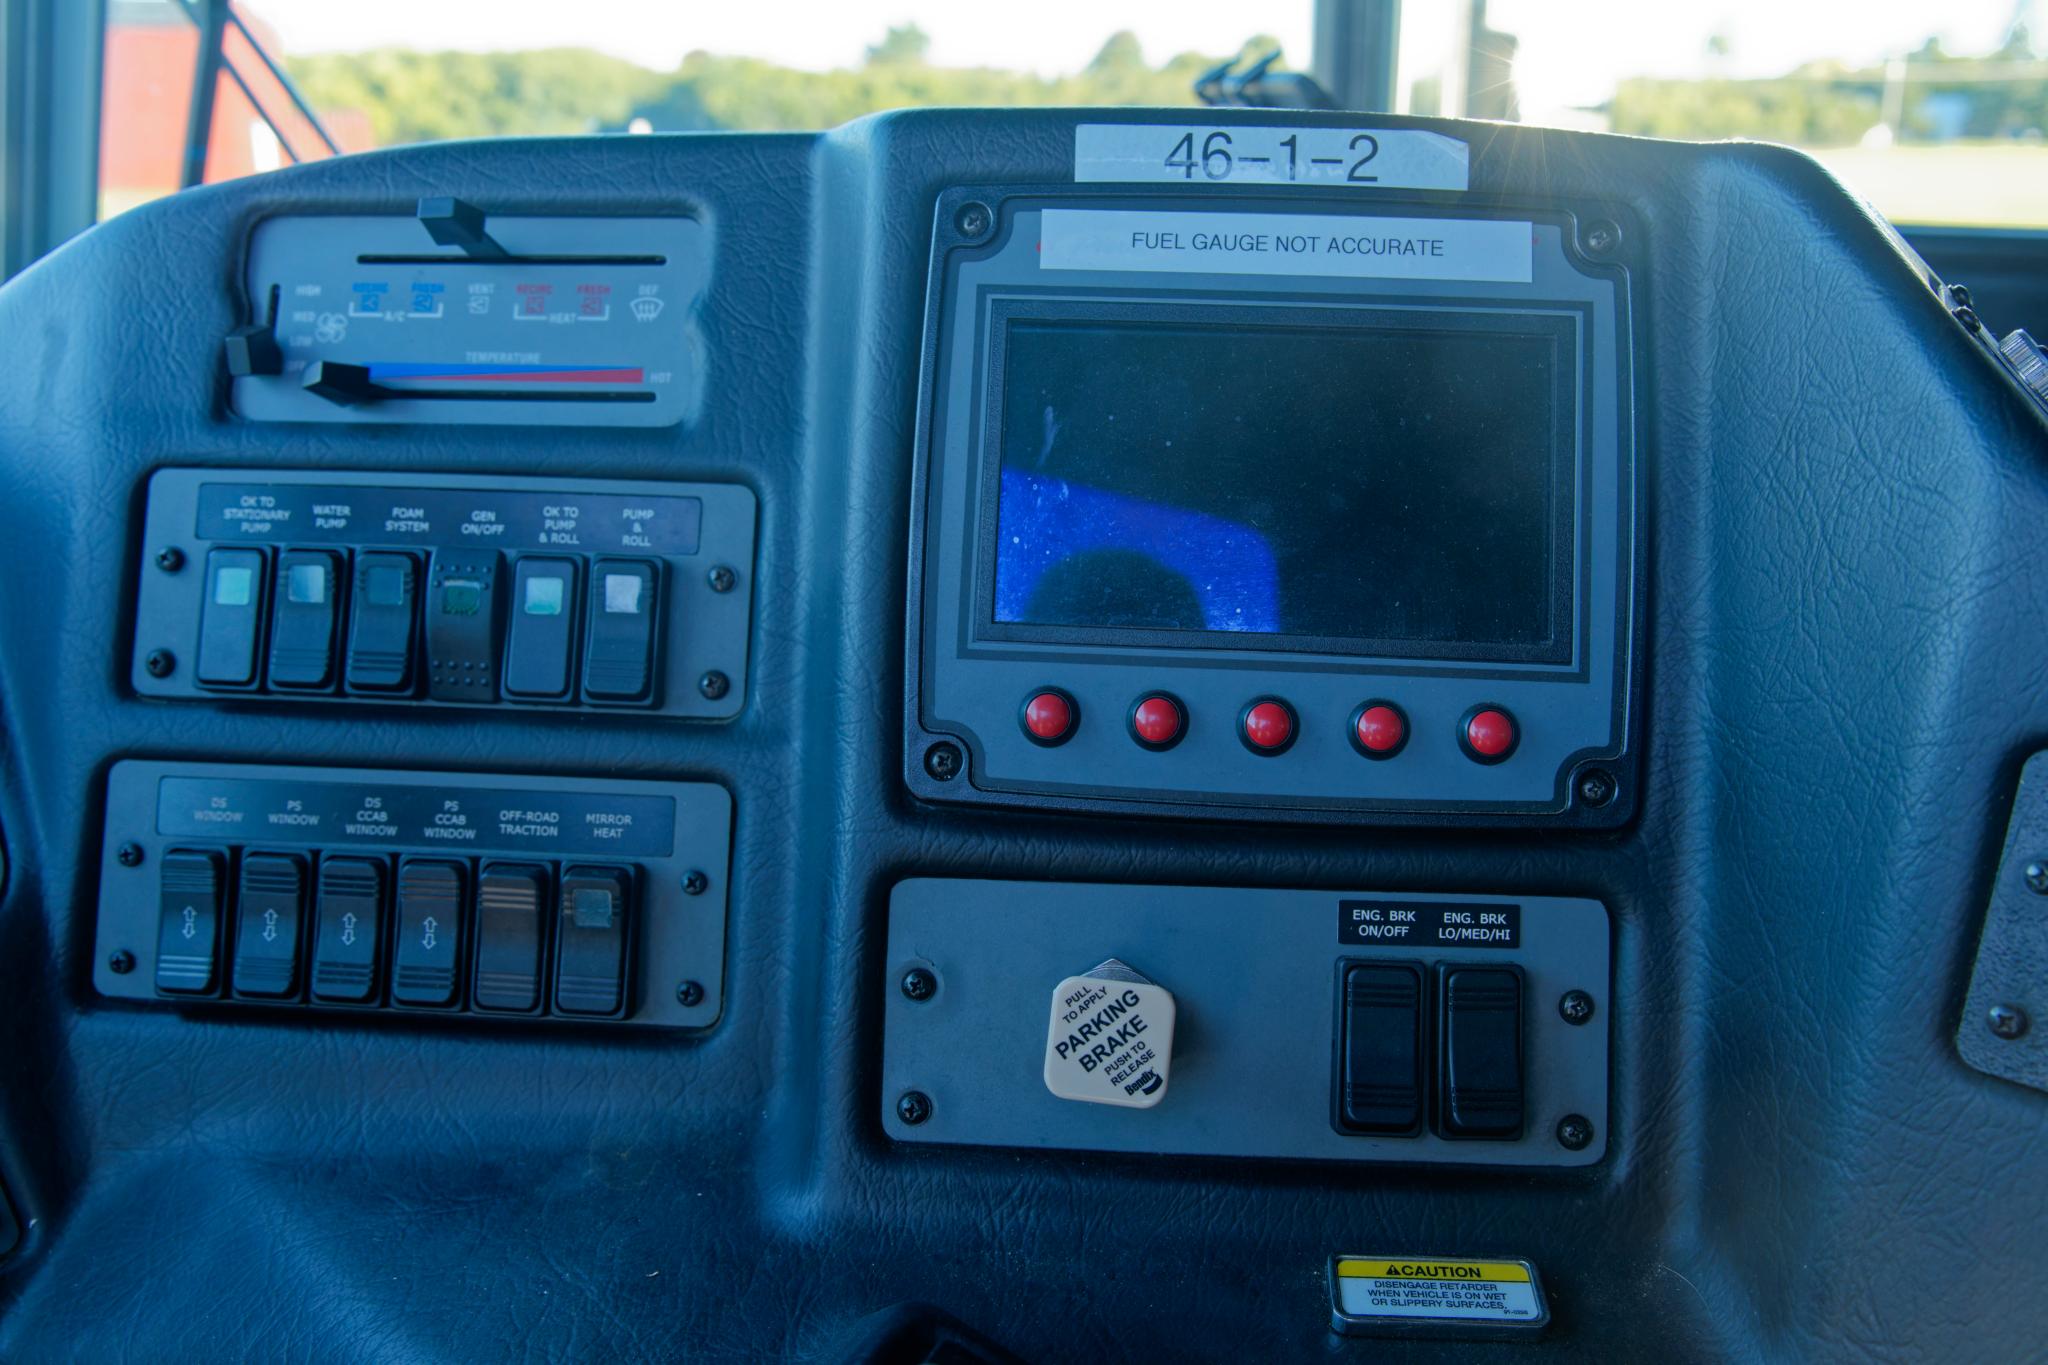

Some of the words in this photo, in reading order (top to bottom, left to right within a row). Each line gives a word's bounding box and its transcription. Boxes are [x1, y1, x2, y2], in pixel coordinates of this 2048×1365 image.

[1164, 131, 1379, 183] 46-1-2
[1132, 232, 1185, 250] FUEL
[1193, 234, 1268, 252] GAUGE
[1276, 236, 1320, 254] NOT
[1327, 238, 1444, 257] ACCURATE
[468, 284, 494, 295] VENT
[549, 313, 577, 324] HEAT
[465, 351, 541, 364] TEMPERATURE
[650, 372, 671, 384] HOT
[241, 496, 255, 506] OK
[258, 497, 275, 507] TO
[223, 508, 291, 521] STATIONARY
[313, 505, 351, 516] WATER
[392, 507, 424, 519] FOAM
[472, 510, 496, 523] GEN
[542, 506, 558, 518] OK
[561, 507, 579, 519] TO
[623, 509, 654, 521] PUMP
[241, 521, 271, 534] PUMP
[315, 517, 347, 529] PUMP
[385, 520, 429, 532] SYSTEM
[461, 523, 505, 536] ON/OFF
[545, 519, 576, 531] PUMP
[550, 532, 580, 545] ROLL
[622, 534, 651, 547] ROLL
[211, 798, 227, 809] DS
[287, 801, 302, 812] PS
[365, 798, 381, 809] DS
[444, 801, 459, 812] PS
[194, 810, 243, 823] WINDOW
[268, 812, 319, 826] WINDOW
[356, 810, 388, 822] CCAB
[435, 813, 467, 826] CCAB
[499, 810, 559, 824] OFF-ROAD
[586, 812, 632, 826] MIRROR
[346, 823, 397, 837] WINDOW
[424, 826, 476, 840] WINDOW
[499, 822, 558, 837] TRACTION
[593, 826, 623, 839] HEAT
[1352, 910, 1384, 921] ENG.
[1390, 911, 1416, 922] BRK
[1443, 912, 1475, 924] ENG.
[1480, 913, 1506, 924] BRK
[1358, 925, 1409, 938] ON/OFF
[1439, 928, 1511, 941] LO/MED/HI
[1065, 986, 1092, 1007] PULL
[1063, 1010, 1078, 1023] TO
[1078, 986, 1108, 1014] APPLY
[1055, 990, 1140, 1060] PARKING
[1078, 1015, 1148, 1072] BRAKE
[1104, 1053, 1132, 1075] PUSH
[1131, 1041, 1146, 1054] TO
[1110, 1049, 1156, 1086] RELEASE
[1124, 1068, 1158, 1096] Bendix
[1401, 1265, 1481, 1278] CAUTION
[1374, 1281, 1437, 1290] DISENGAGE
[1440, 1283, 1497, 1291] RETARDER
[1368, 1290, 1401, 1298] WHEN
[1403, 1291, 1449, 1299] VEHICLE
[1464, 1292, 1481, 1300] ON
[1371, 1298, 1388, 1306] OR
[1390, 1299, 1443, 1308] SLIPPERY
[1446, 1301, 1508, 1309] SURFACES.
